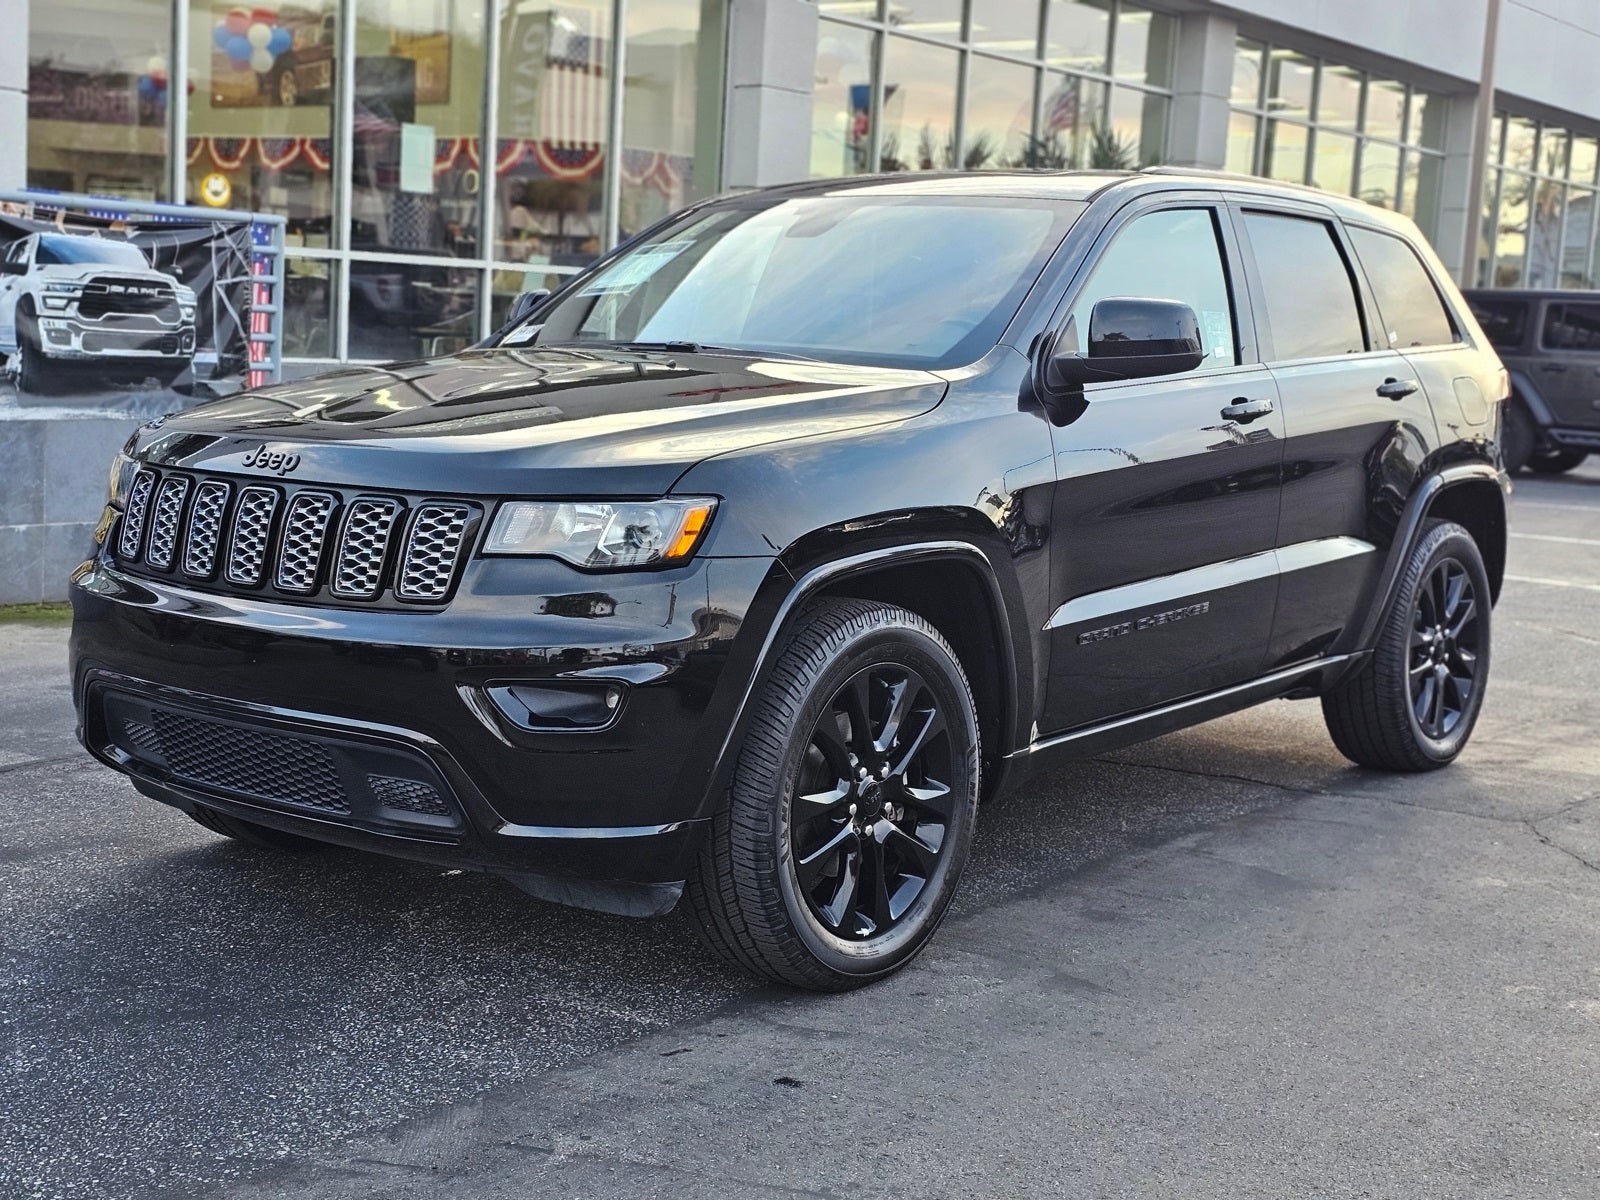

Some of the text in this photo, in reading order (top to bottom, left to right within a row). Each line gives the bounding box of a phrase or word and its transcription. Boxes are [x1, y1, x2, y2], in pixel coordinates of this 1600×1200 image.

[109, 284, 155, 295] RAM
[241, 444, 301, 476] Jeep
[1077, 601, 1210, 645] GRAND CHEROKEE
